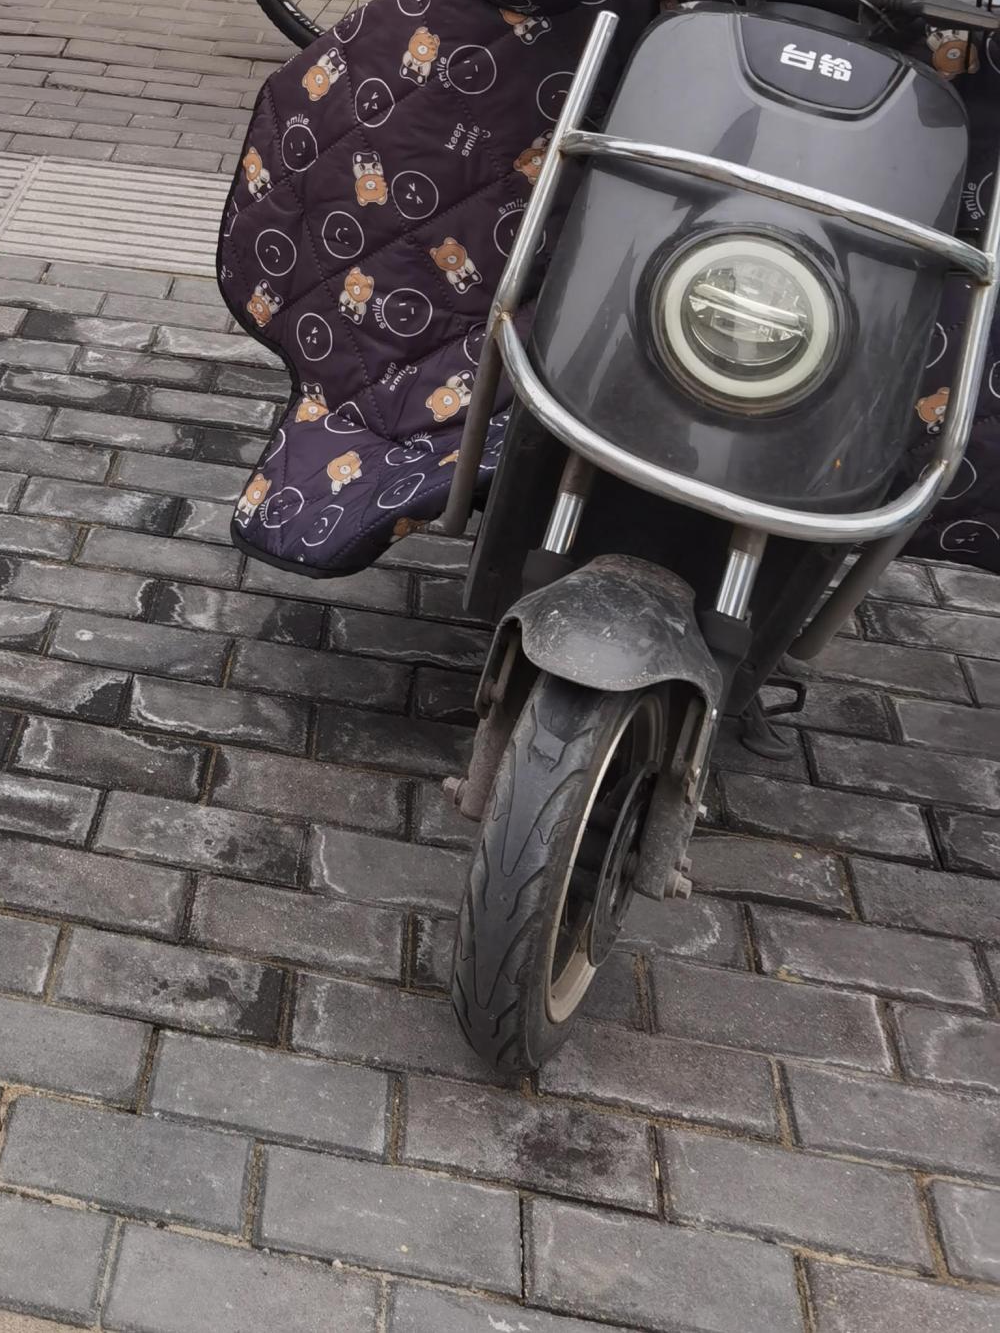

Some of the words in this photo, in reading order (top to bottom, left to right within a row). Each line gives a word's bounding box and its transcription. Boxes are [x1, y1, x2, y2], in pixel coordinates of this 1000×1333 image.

[436, 56, 451, 89] smile
[779, 43, 853, 83] 台铃
[285, 114, 310, 127] smile
[444, 122, 466, 150] keep
[461, 125, 480, 157] smile
[963, 182, 981, 220] smile
[371, 297, 386, 329] smile
